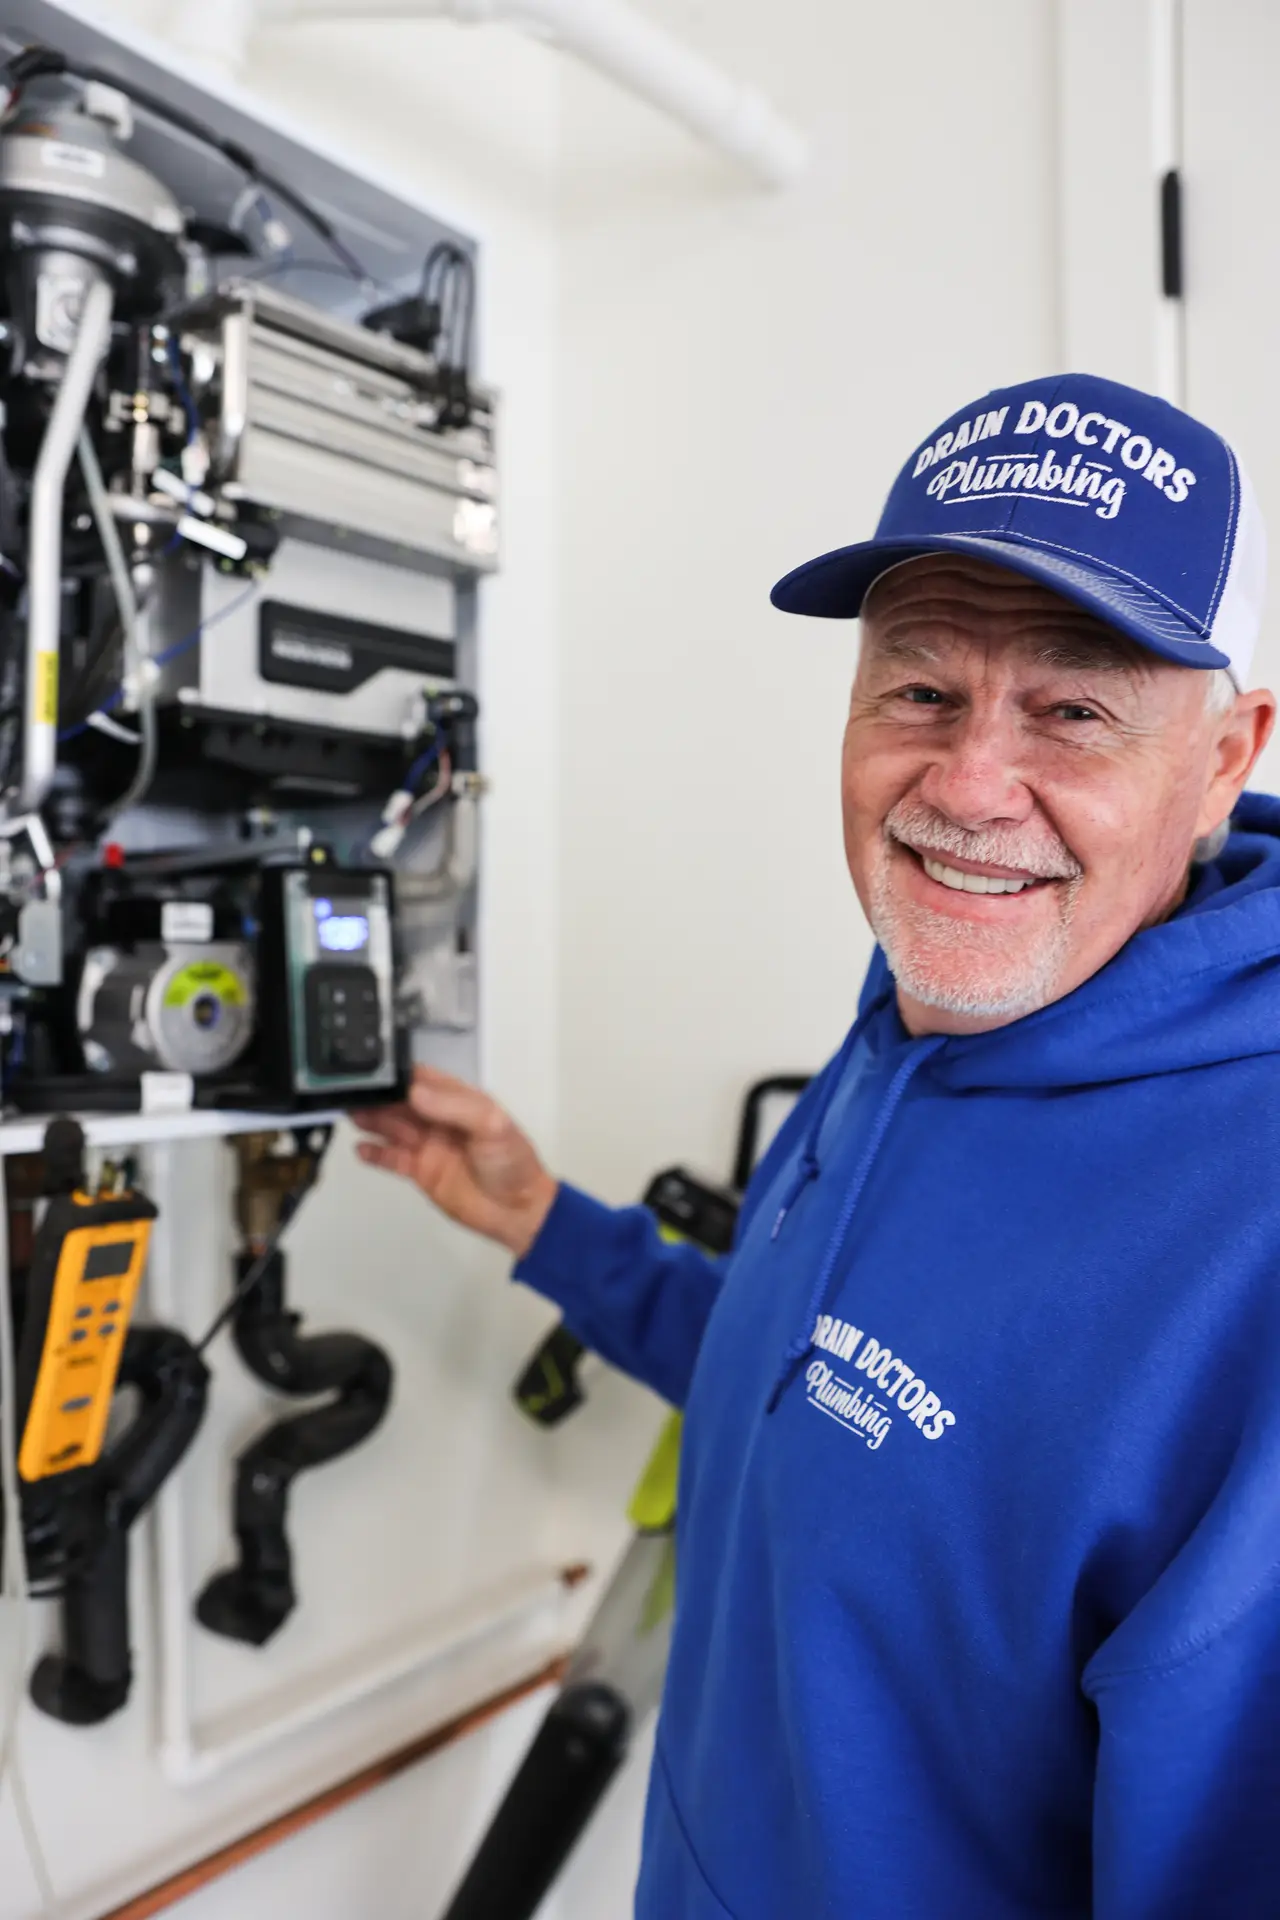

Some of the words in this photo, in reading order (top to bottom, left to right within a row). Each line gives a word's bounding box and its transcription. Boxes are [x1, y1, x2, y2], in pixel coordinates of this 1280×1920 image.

[912, 406, 1010, 478] DRAIN
[1013, 400, 1197, 503] DOCTORS
[926, 449, 1128, 520] Plumbing
[805, 1360, 893, 1450] Plumbing
[854, 1337, 956, 1440] DOCTORS
